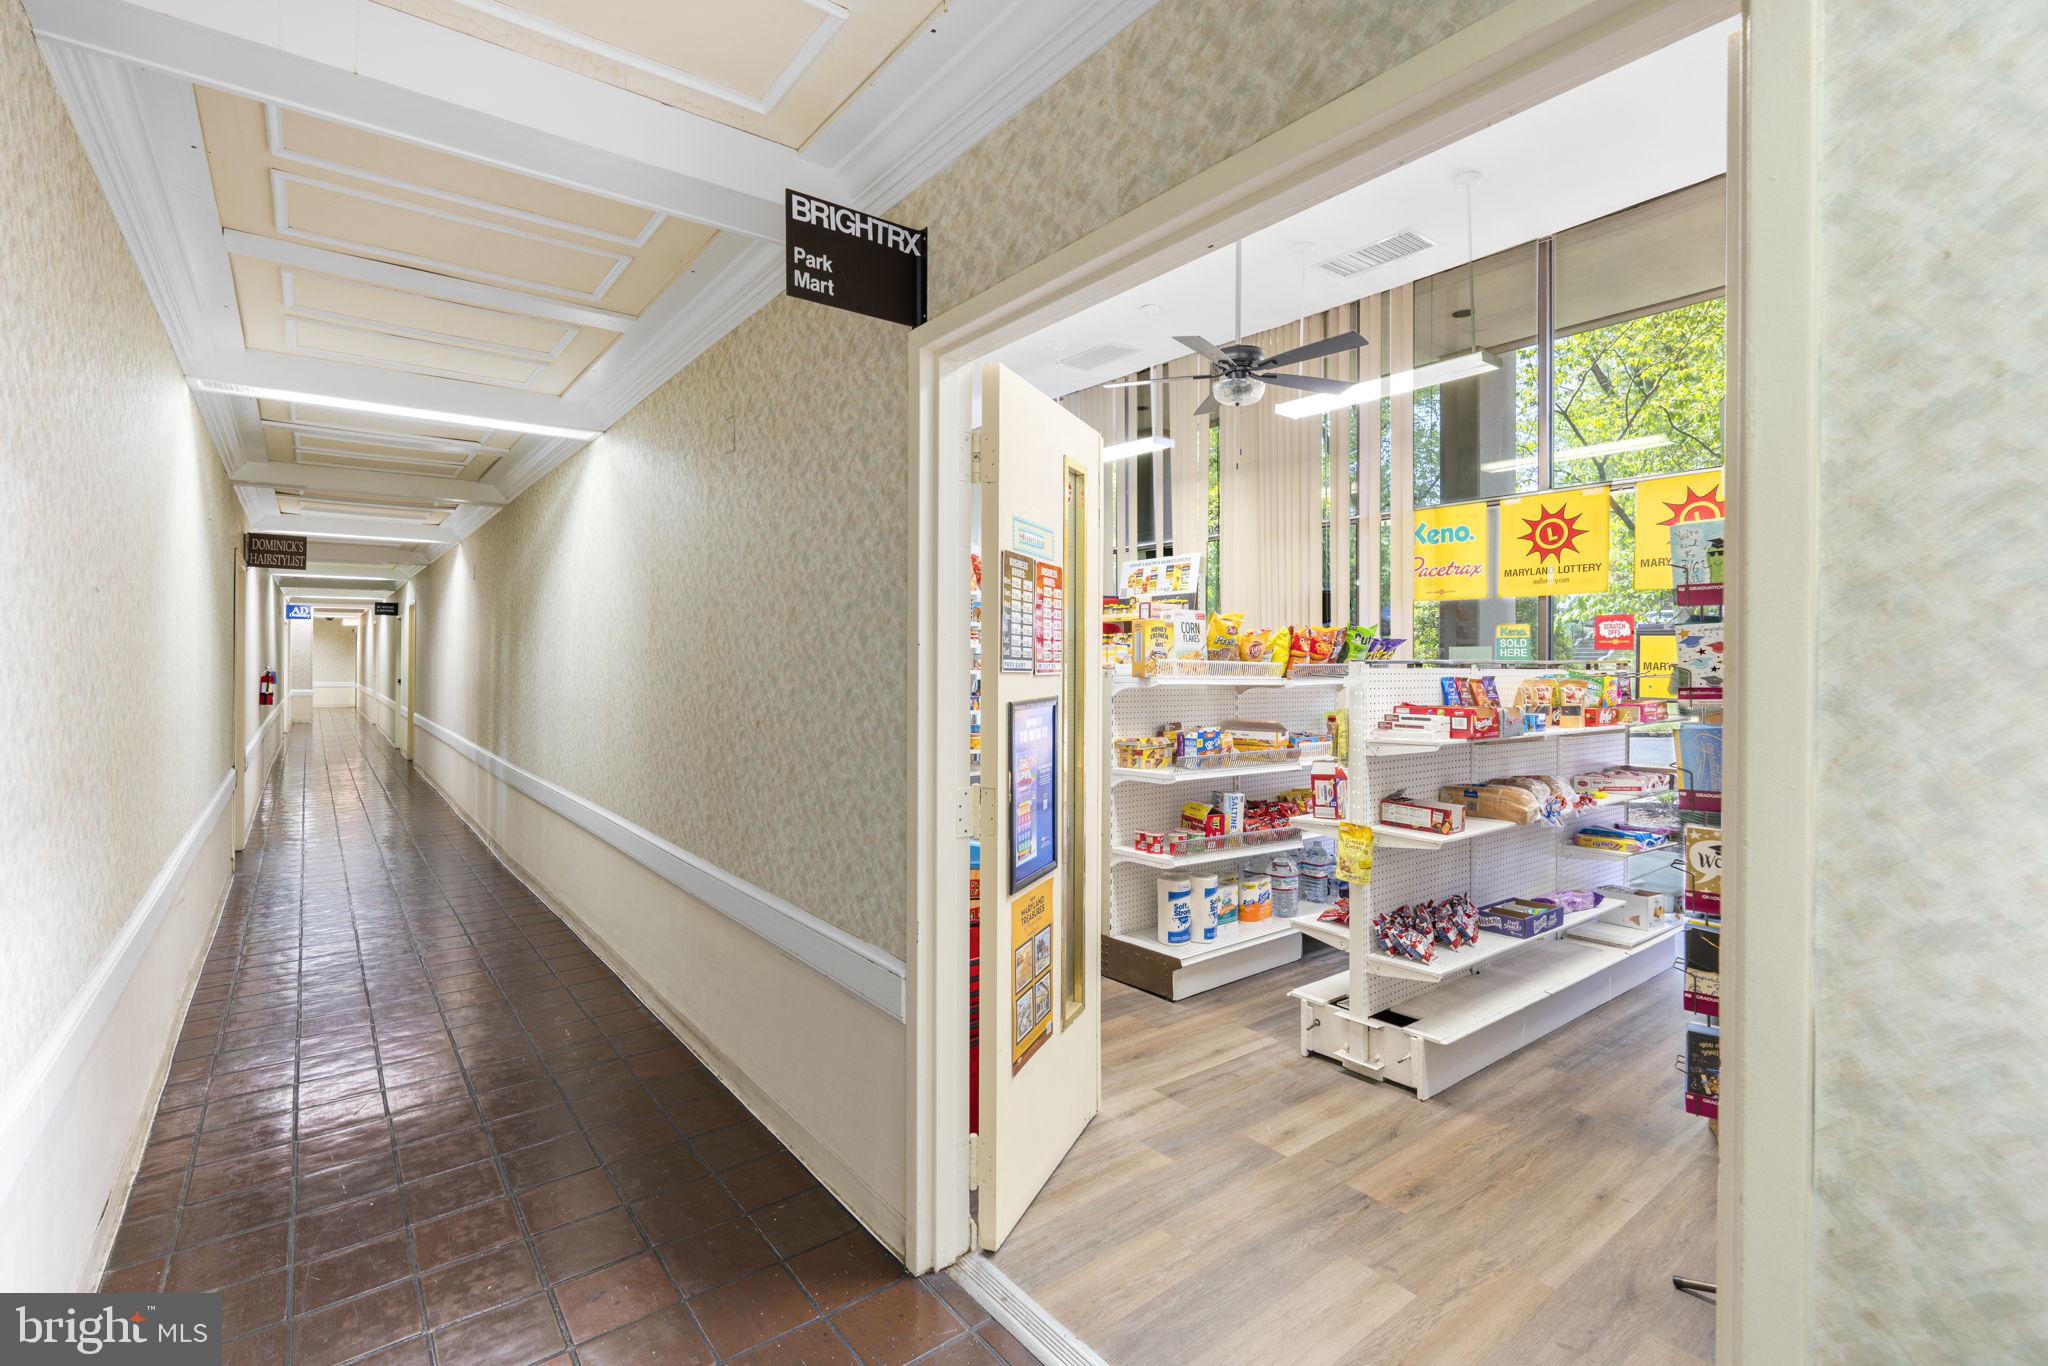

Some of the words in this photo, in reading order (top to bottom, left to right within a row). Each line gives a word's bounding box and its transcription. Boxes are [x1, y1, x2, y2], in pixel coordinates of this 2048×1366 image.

[791, 193, 921, 257] BRIGHTRX
[794, 246, 833, 273] Park
[794, 269, 835, 296] Mart
[252, 538, 304, 553] DOMINICK'S
[250, 553, 305, 567] HAIRSTYLIST
[1558, 563, 1602, 574] LOTTERY
[1181, 621, 1200, 635] CORN
[1183, 634, 1200, 643] FLAKES
[1500, 638, 1527, 647] SOLD
[1500, 649, 1527, 657] HERE
[1230, 795, 1239, 830] SALTINE
